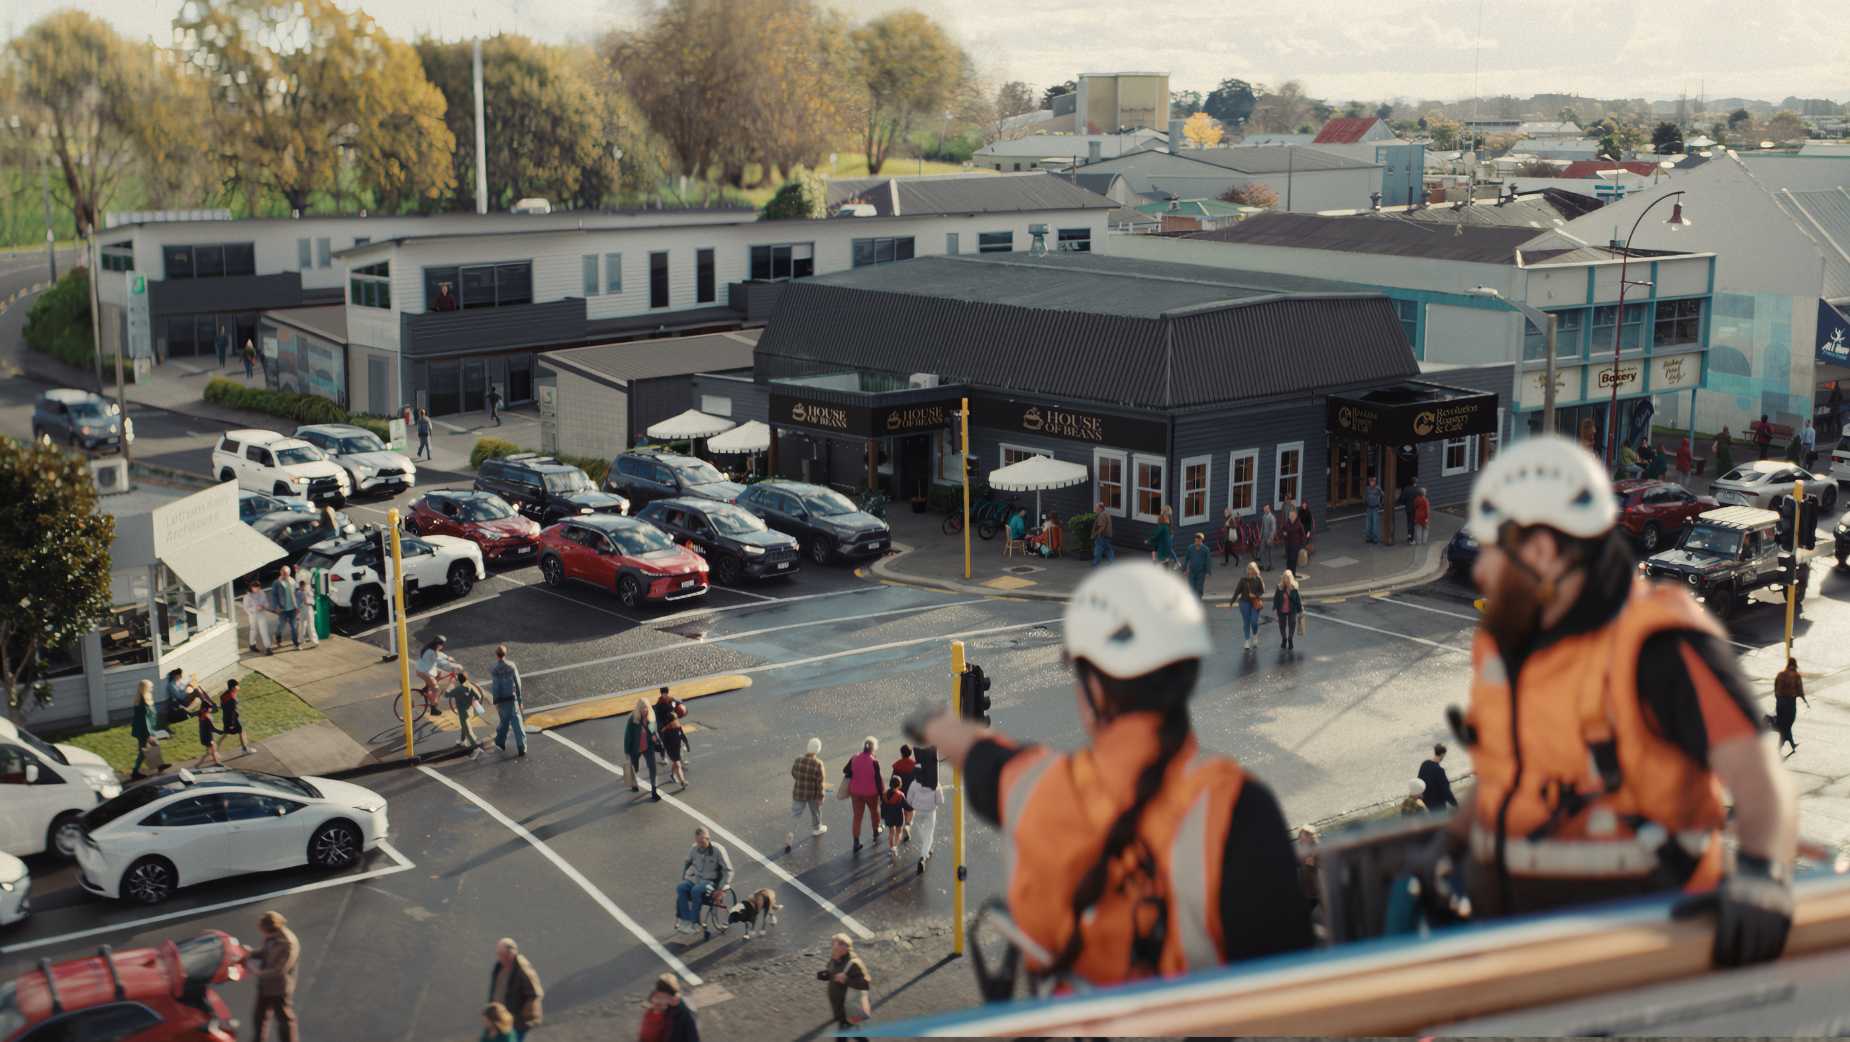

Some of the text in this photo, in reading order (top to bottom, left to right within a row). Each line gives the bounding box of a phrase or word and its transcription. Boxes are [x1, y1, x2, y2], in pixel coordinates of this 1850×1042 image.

[1602, 372, 1637, 383] Bakery
[808, 405, 846, 421] HOUSE
[903, 407, 943, 420] HOUSE
[807, 415, 847, 428] OF BEANS
[902, 415, 943, 427] OF BEANS
[1047, 410, 1102, 431] HOUSE
[1045, 423, 1102, 441] OF BEANS
